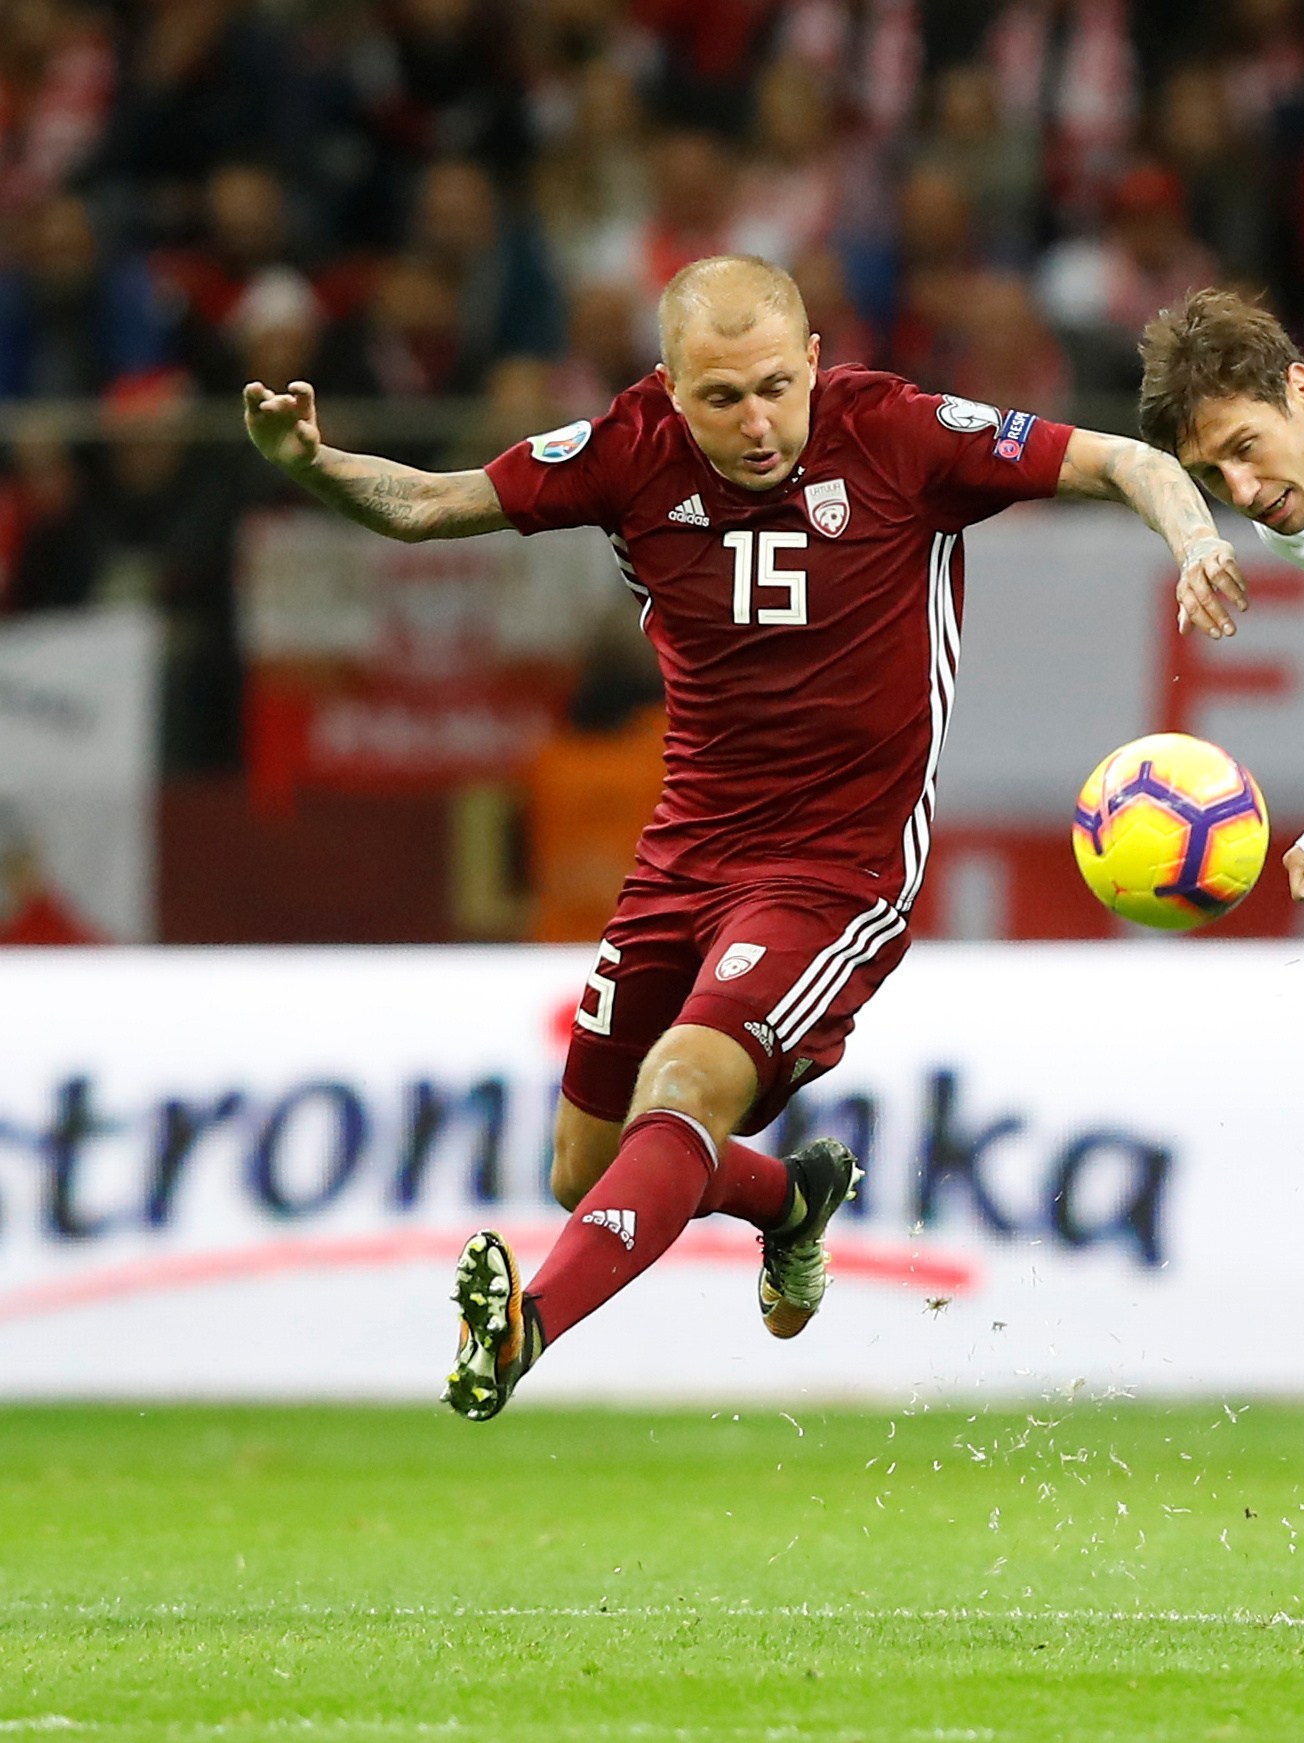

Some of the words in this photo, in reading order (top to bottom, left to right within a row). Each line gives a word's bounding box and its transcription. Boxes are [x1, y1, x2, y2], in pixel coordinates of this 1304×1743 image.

[668, 510, 710, 527] adidas
[723, 530, 808, 625] 15
[744, 1021, 774, 1058] adidas
[582, 1214, 636, 1251] adidas
